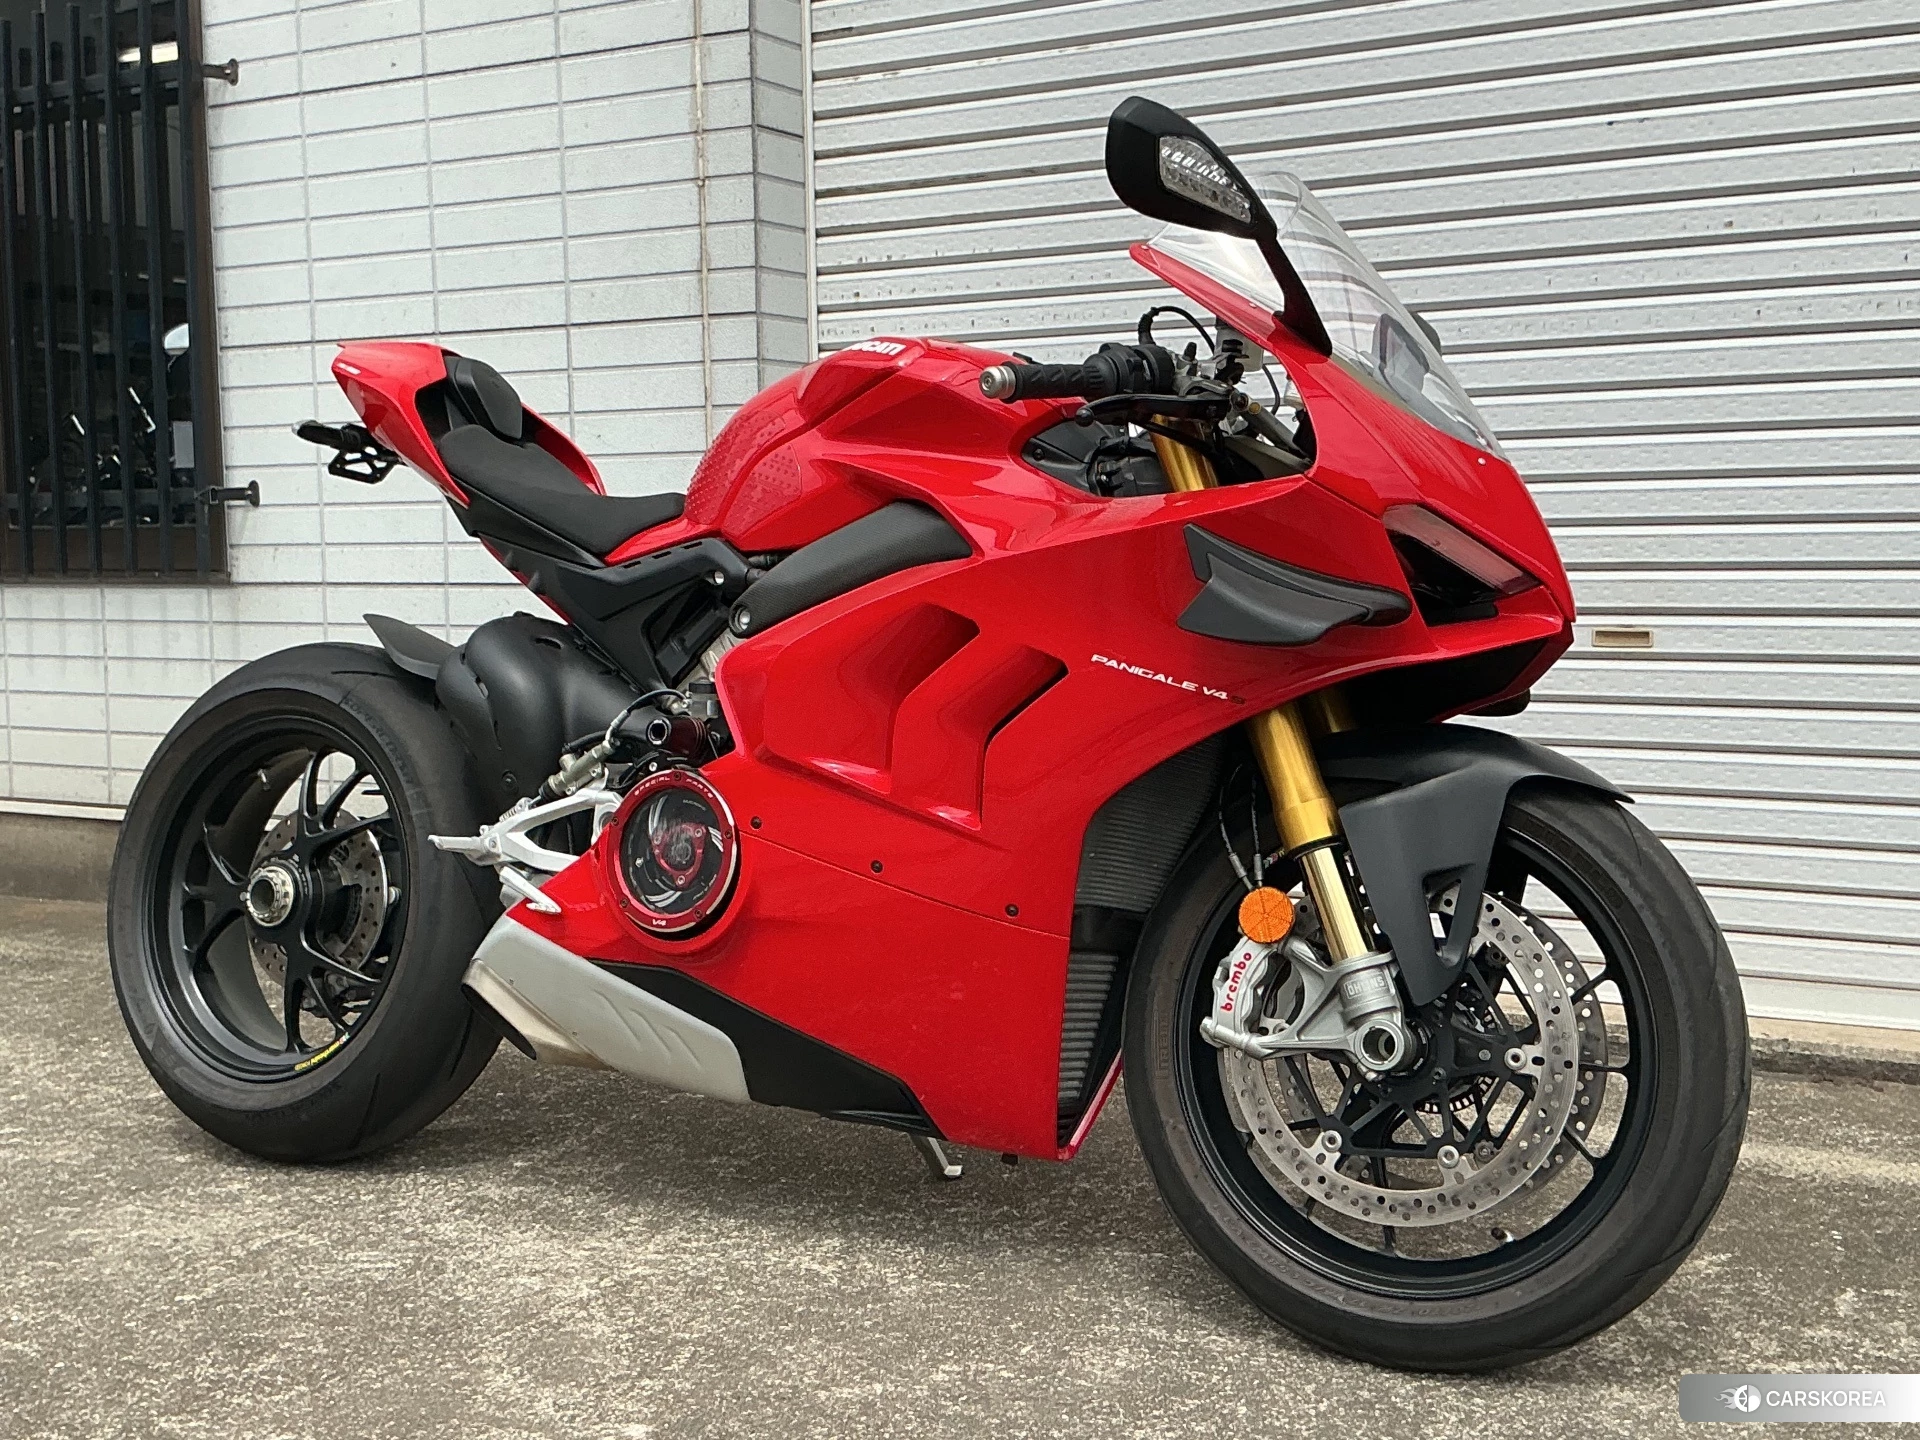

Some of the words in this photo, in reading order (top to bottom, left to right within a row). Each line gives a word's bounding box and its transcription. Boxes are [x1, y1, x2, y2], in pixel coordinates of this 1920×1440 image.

[1091, 654, 1199, 691] PANIGALE
[1203, 686, 1228, 700] V4
[634, 776, 670, 796] SPECIAL
[686, 778, 714, 798] PARTS
[1220, 952, 1252, 1012] brembo
